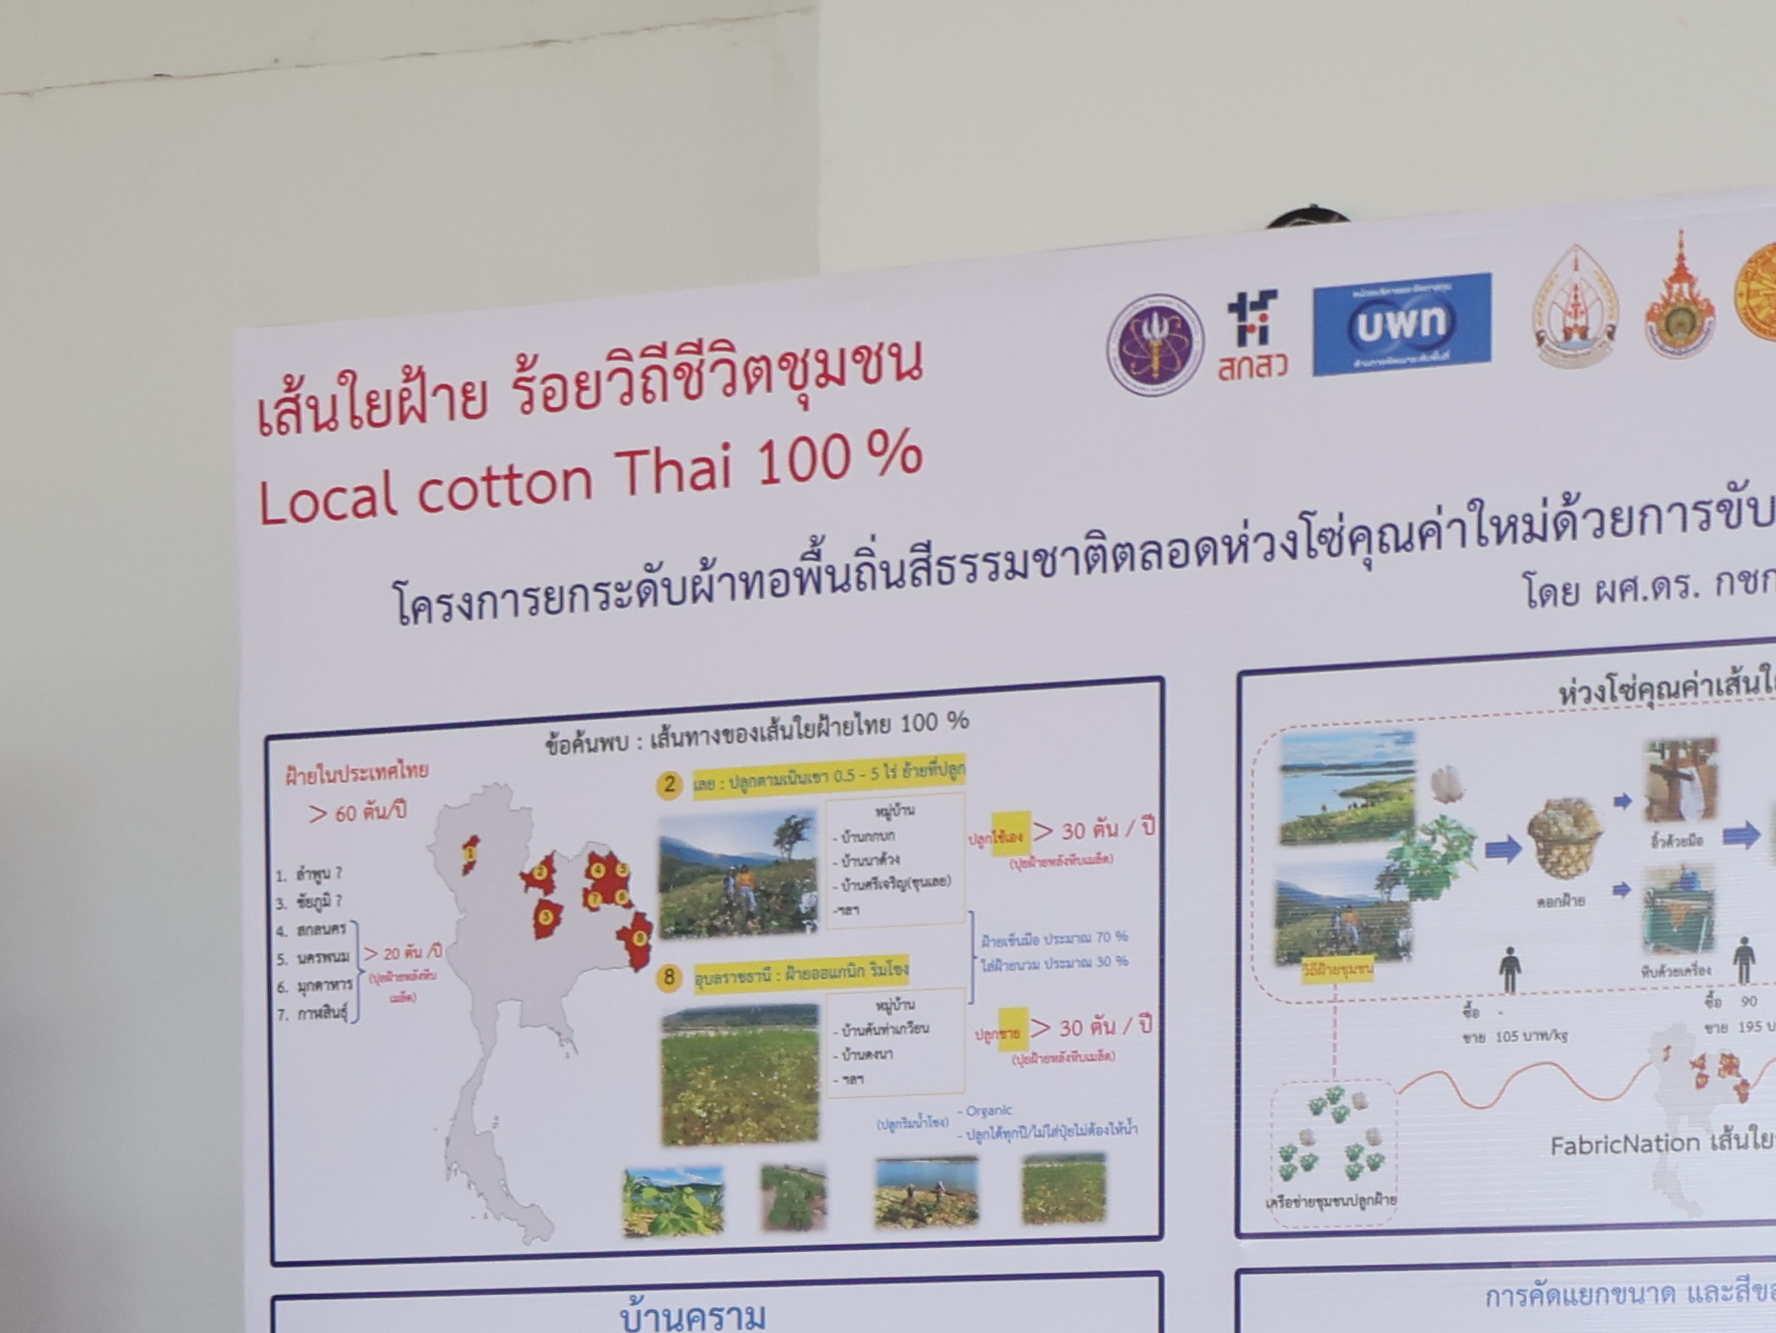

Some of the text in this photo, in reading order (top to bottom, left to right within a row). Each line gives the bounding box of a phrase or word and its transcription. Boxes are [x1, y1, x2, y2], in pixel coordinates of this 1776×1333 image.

[1219, 352, 1290, 382] สกสว
[258, 338, 923, 436] เส้นใยฝ้าย ร้อยวิถีชีวิตชุมชน
[260, 427, 923, 525] Local cotton Thai 100 %
[1523, 570, 1580, 610] โดย
[1595, 574, 1700, 605] ผศ.ดร.
[546, 711, 970, 757] ข้อค้นพบ เส้นทางของเส้นใยฝ้ายไทย 100 %
[285, 758, 429, 787] ฝ้ายในประเทศไทย
[664, 775, 675, 793] 2
[335, 805, 357, 823] 60
[362, 798, 408, 821] ตัน/ปี
[1062, 822, 1086, 841] 30
[1096, 932, 1112, 944] 70
[383, 947, 401, 961] 20
[1096, 956, 1112, 969] 30
[664, 967, 676, 986] 8
[1059, 1019, 1083, 1038] 30
[1738, 1020, 1763, 1034] 195
[1495, 1030, 1519, 1044] 105
[966, 1104, 1014, 1118] Organic
[1550, 1131, 1701, 1158] FabricNation
[1485, 1277, 1678, 1310] การคัดแยกขนาด
